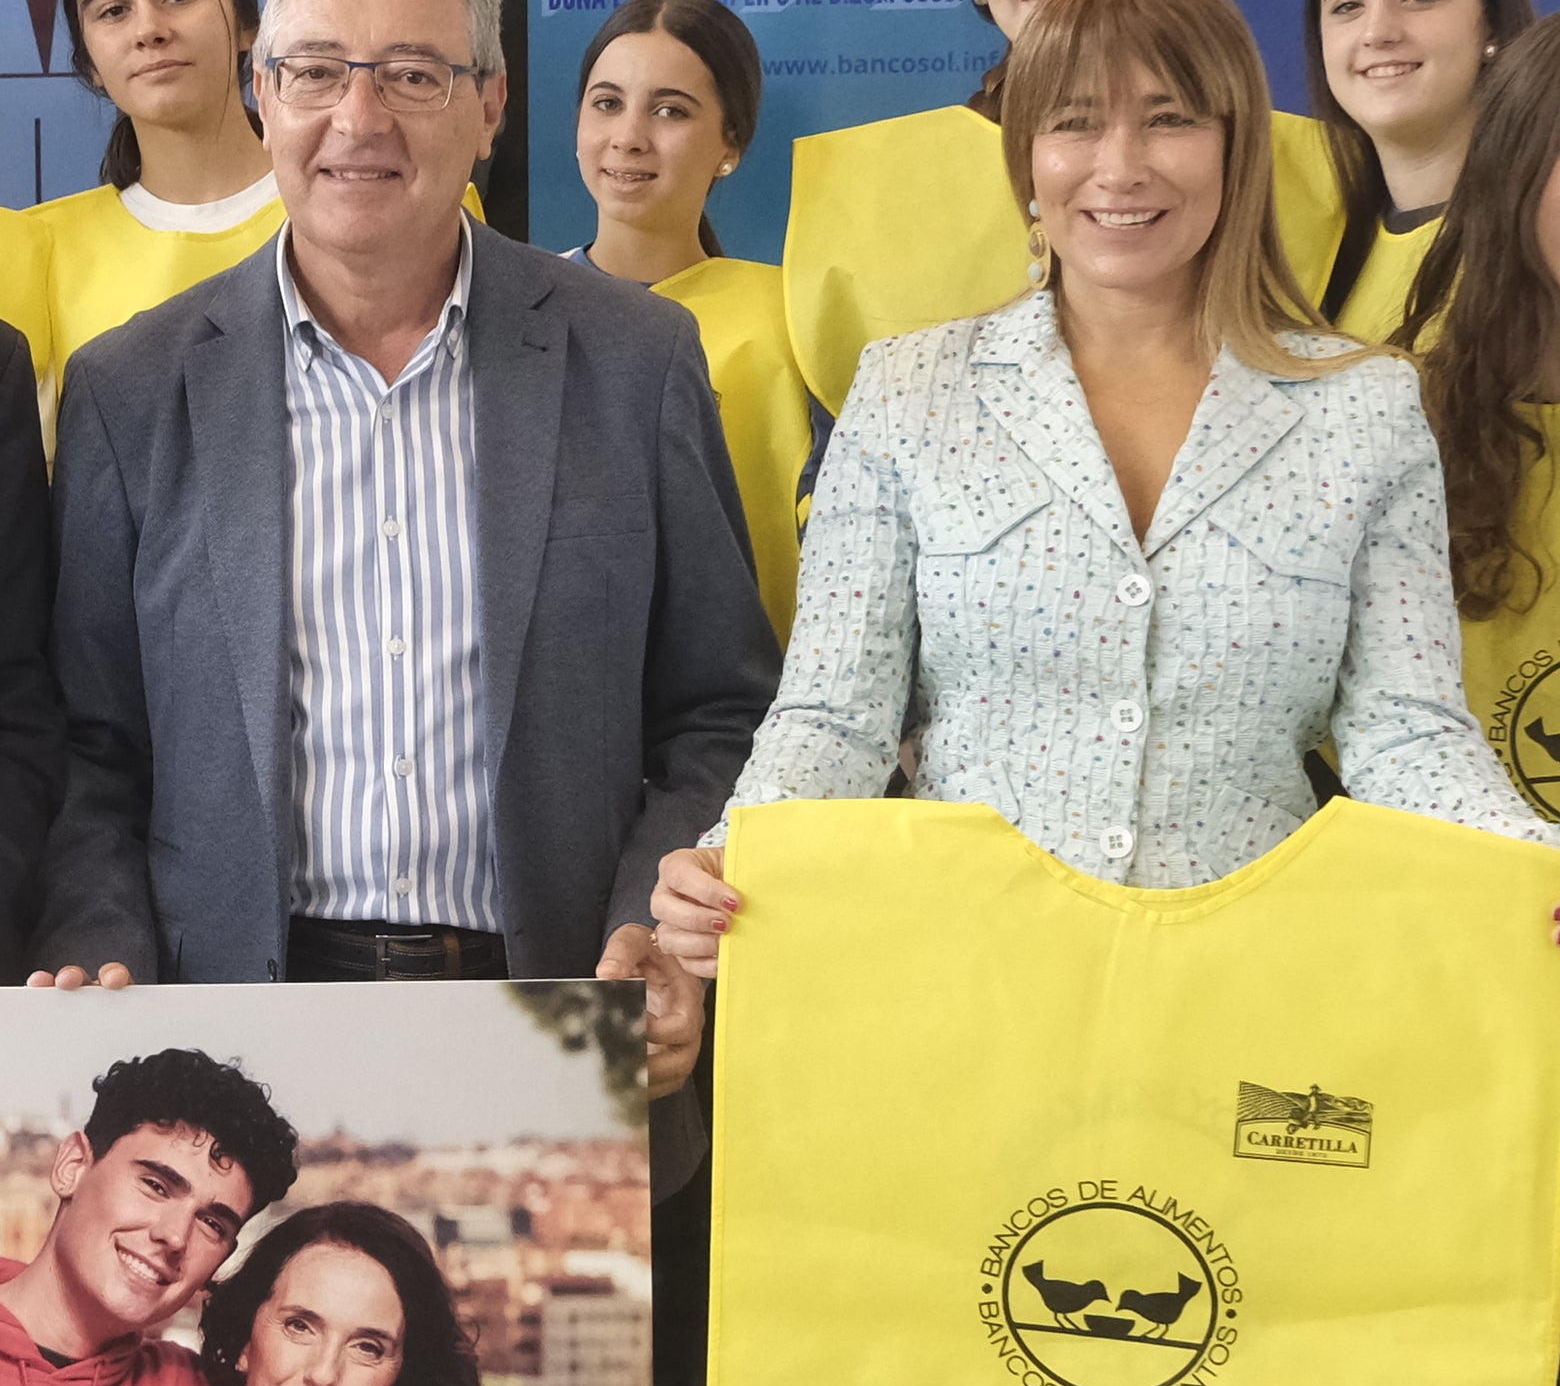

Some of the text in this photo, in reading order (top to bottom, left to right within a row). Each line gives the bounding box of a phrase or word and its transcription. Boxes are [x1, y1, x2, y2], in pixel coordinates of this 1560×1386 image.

[762, 50, 1001, 76] www.bancosol.inf
[1488, 649, 1554, 742] BANCOS
[1246, 1131, 1358, 1153] CARRETILLA
[980, 1179, 1243, 1305] BANCOS DE ALIMENTOS
